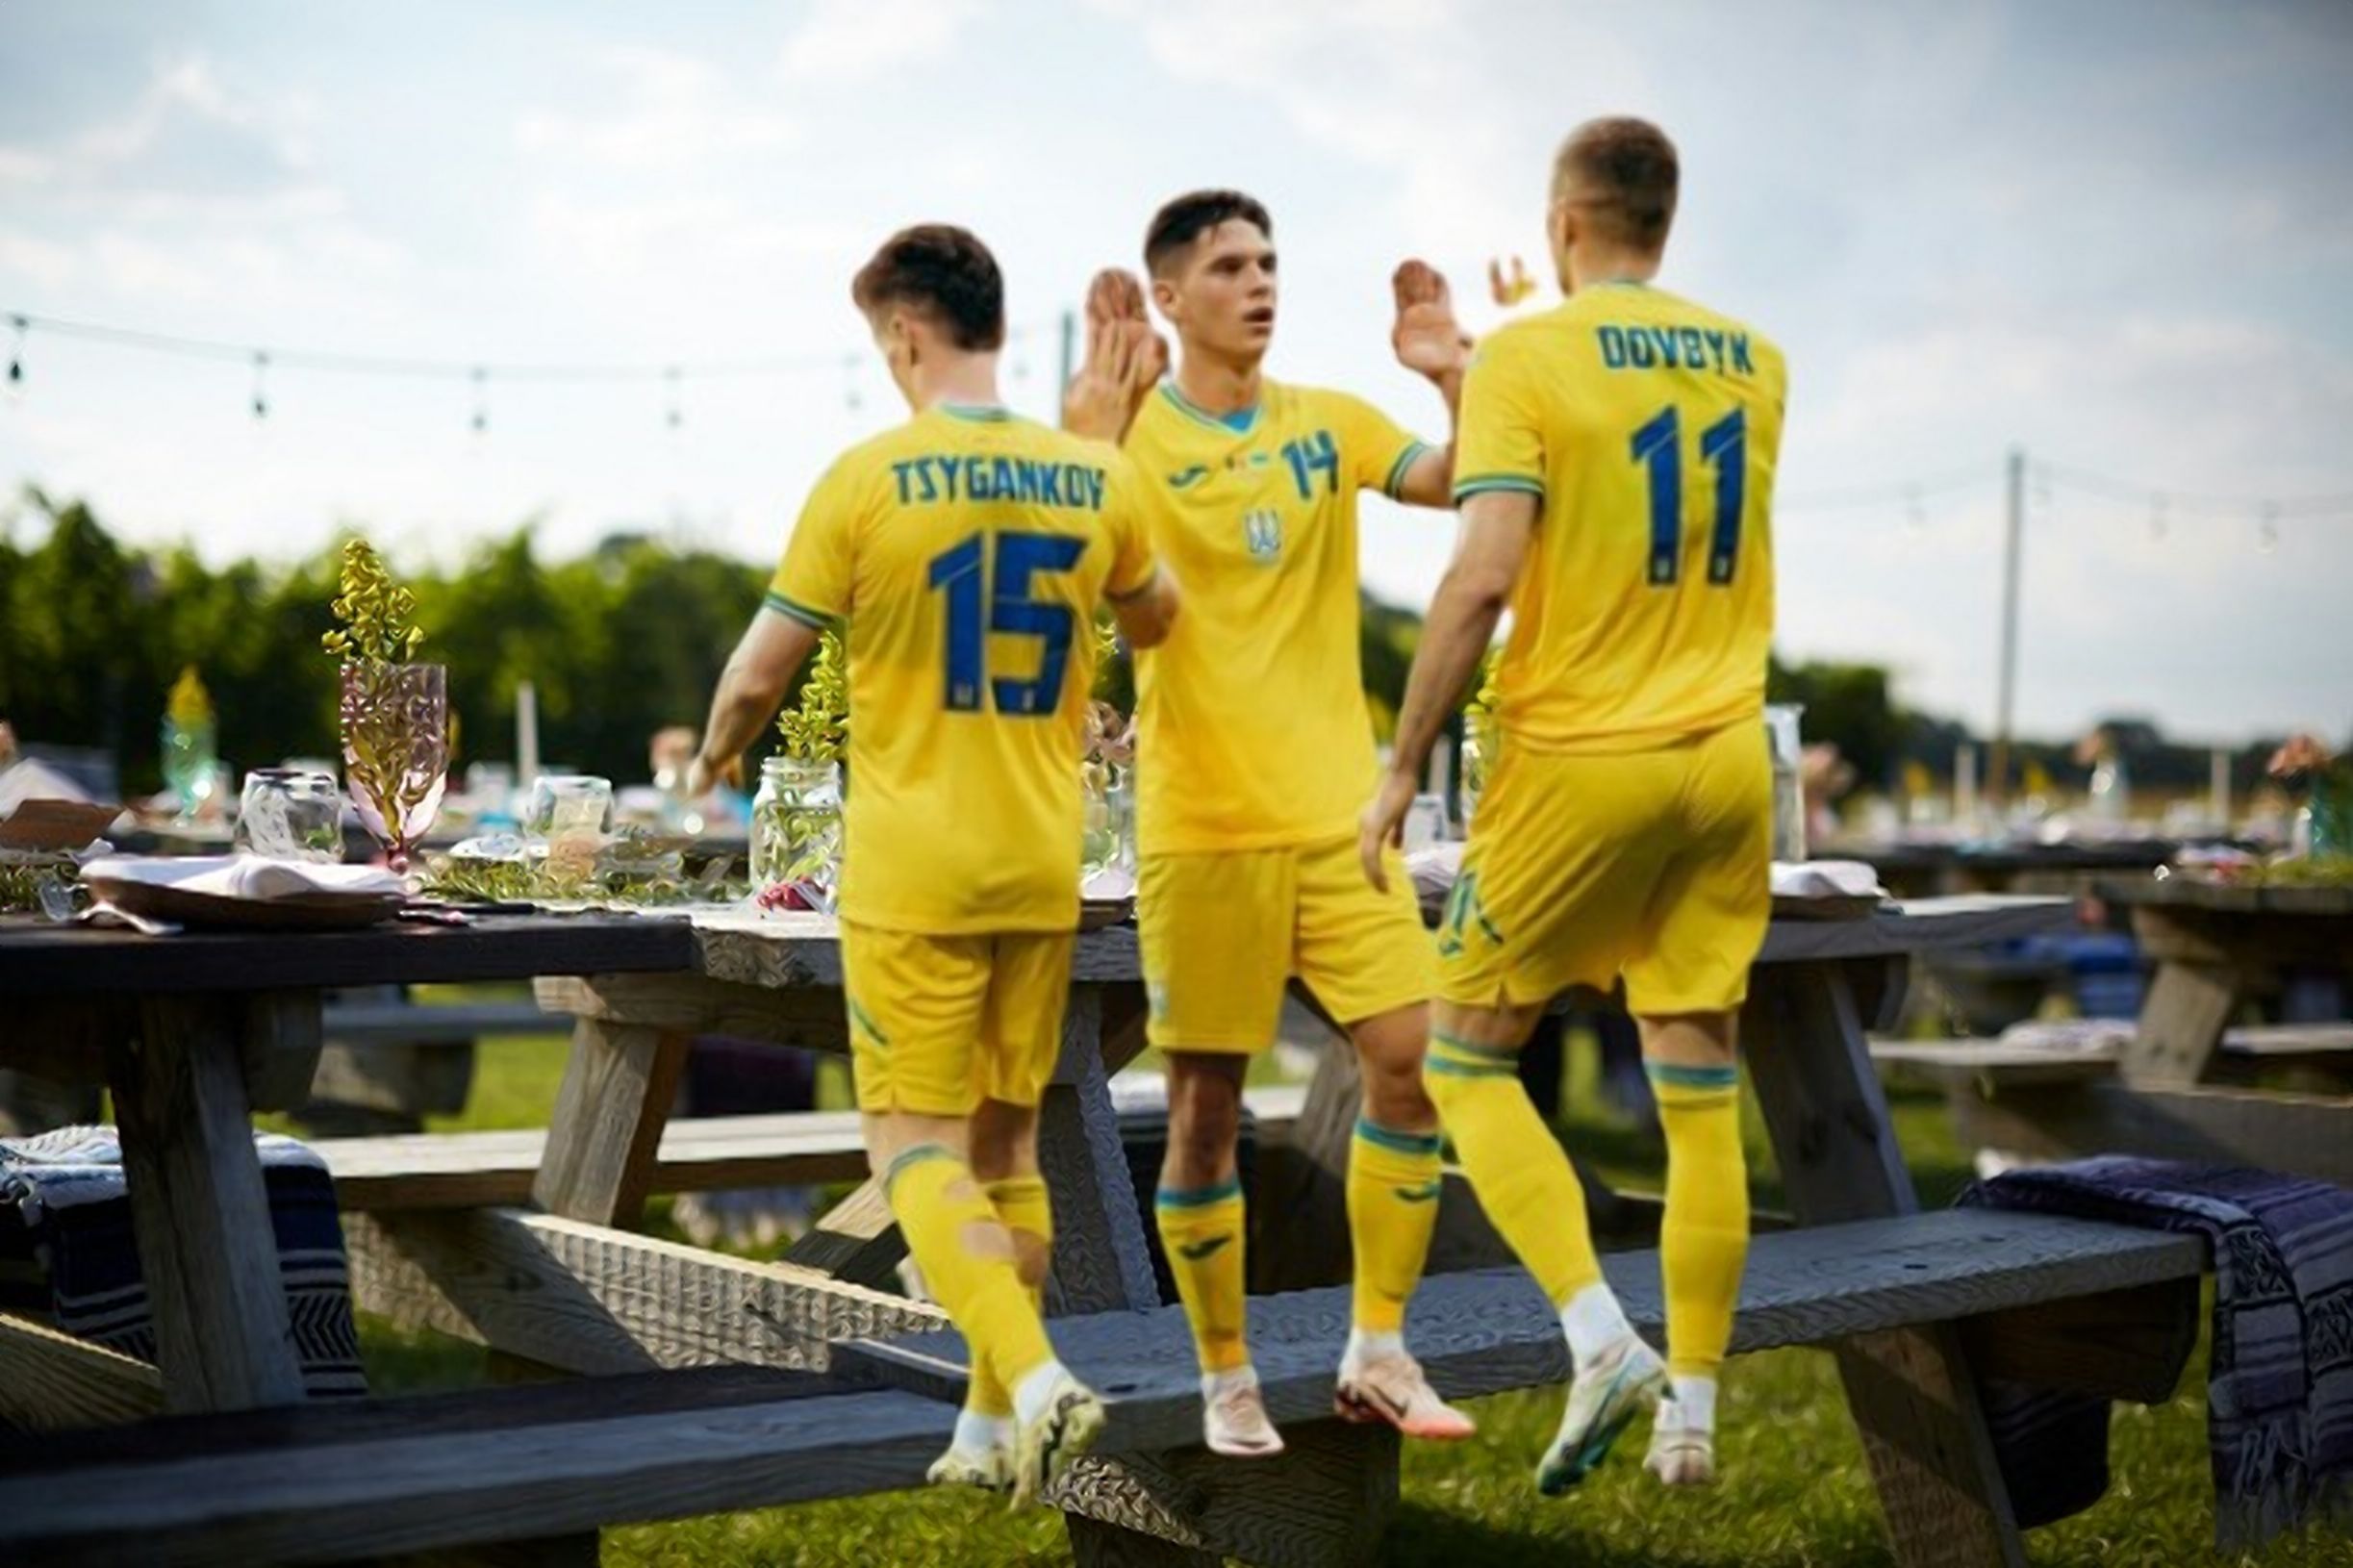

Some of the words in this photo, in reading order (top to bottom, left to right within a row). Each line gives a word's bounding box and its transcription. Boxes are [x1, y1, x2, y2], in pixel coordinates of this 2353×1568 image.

[1597, 325, 1756, 376] DOVBYK
[893, 456, 1104, 511] TSYGANKOV
[1280, 429, 1338, 499] 14
[1631, 405, 1747, 588] 11
[927, 530, 1088, 716] 15
